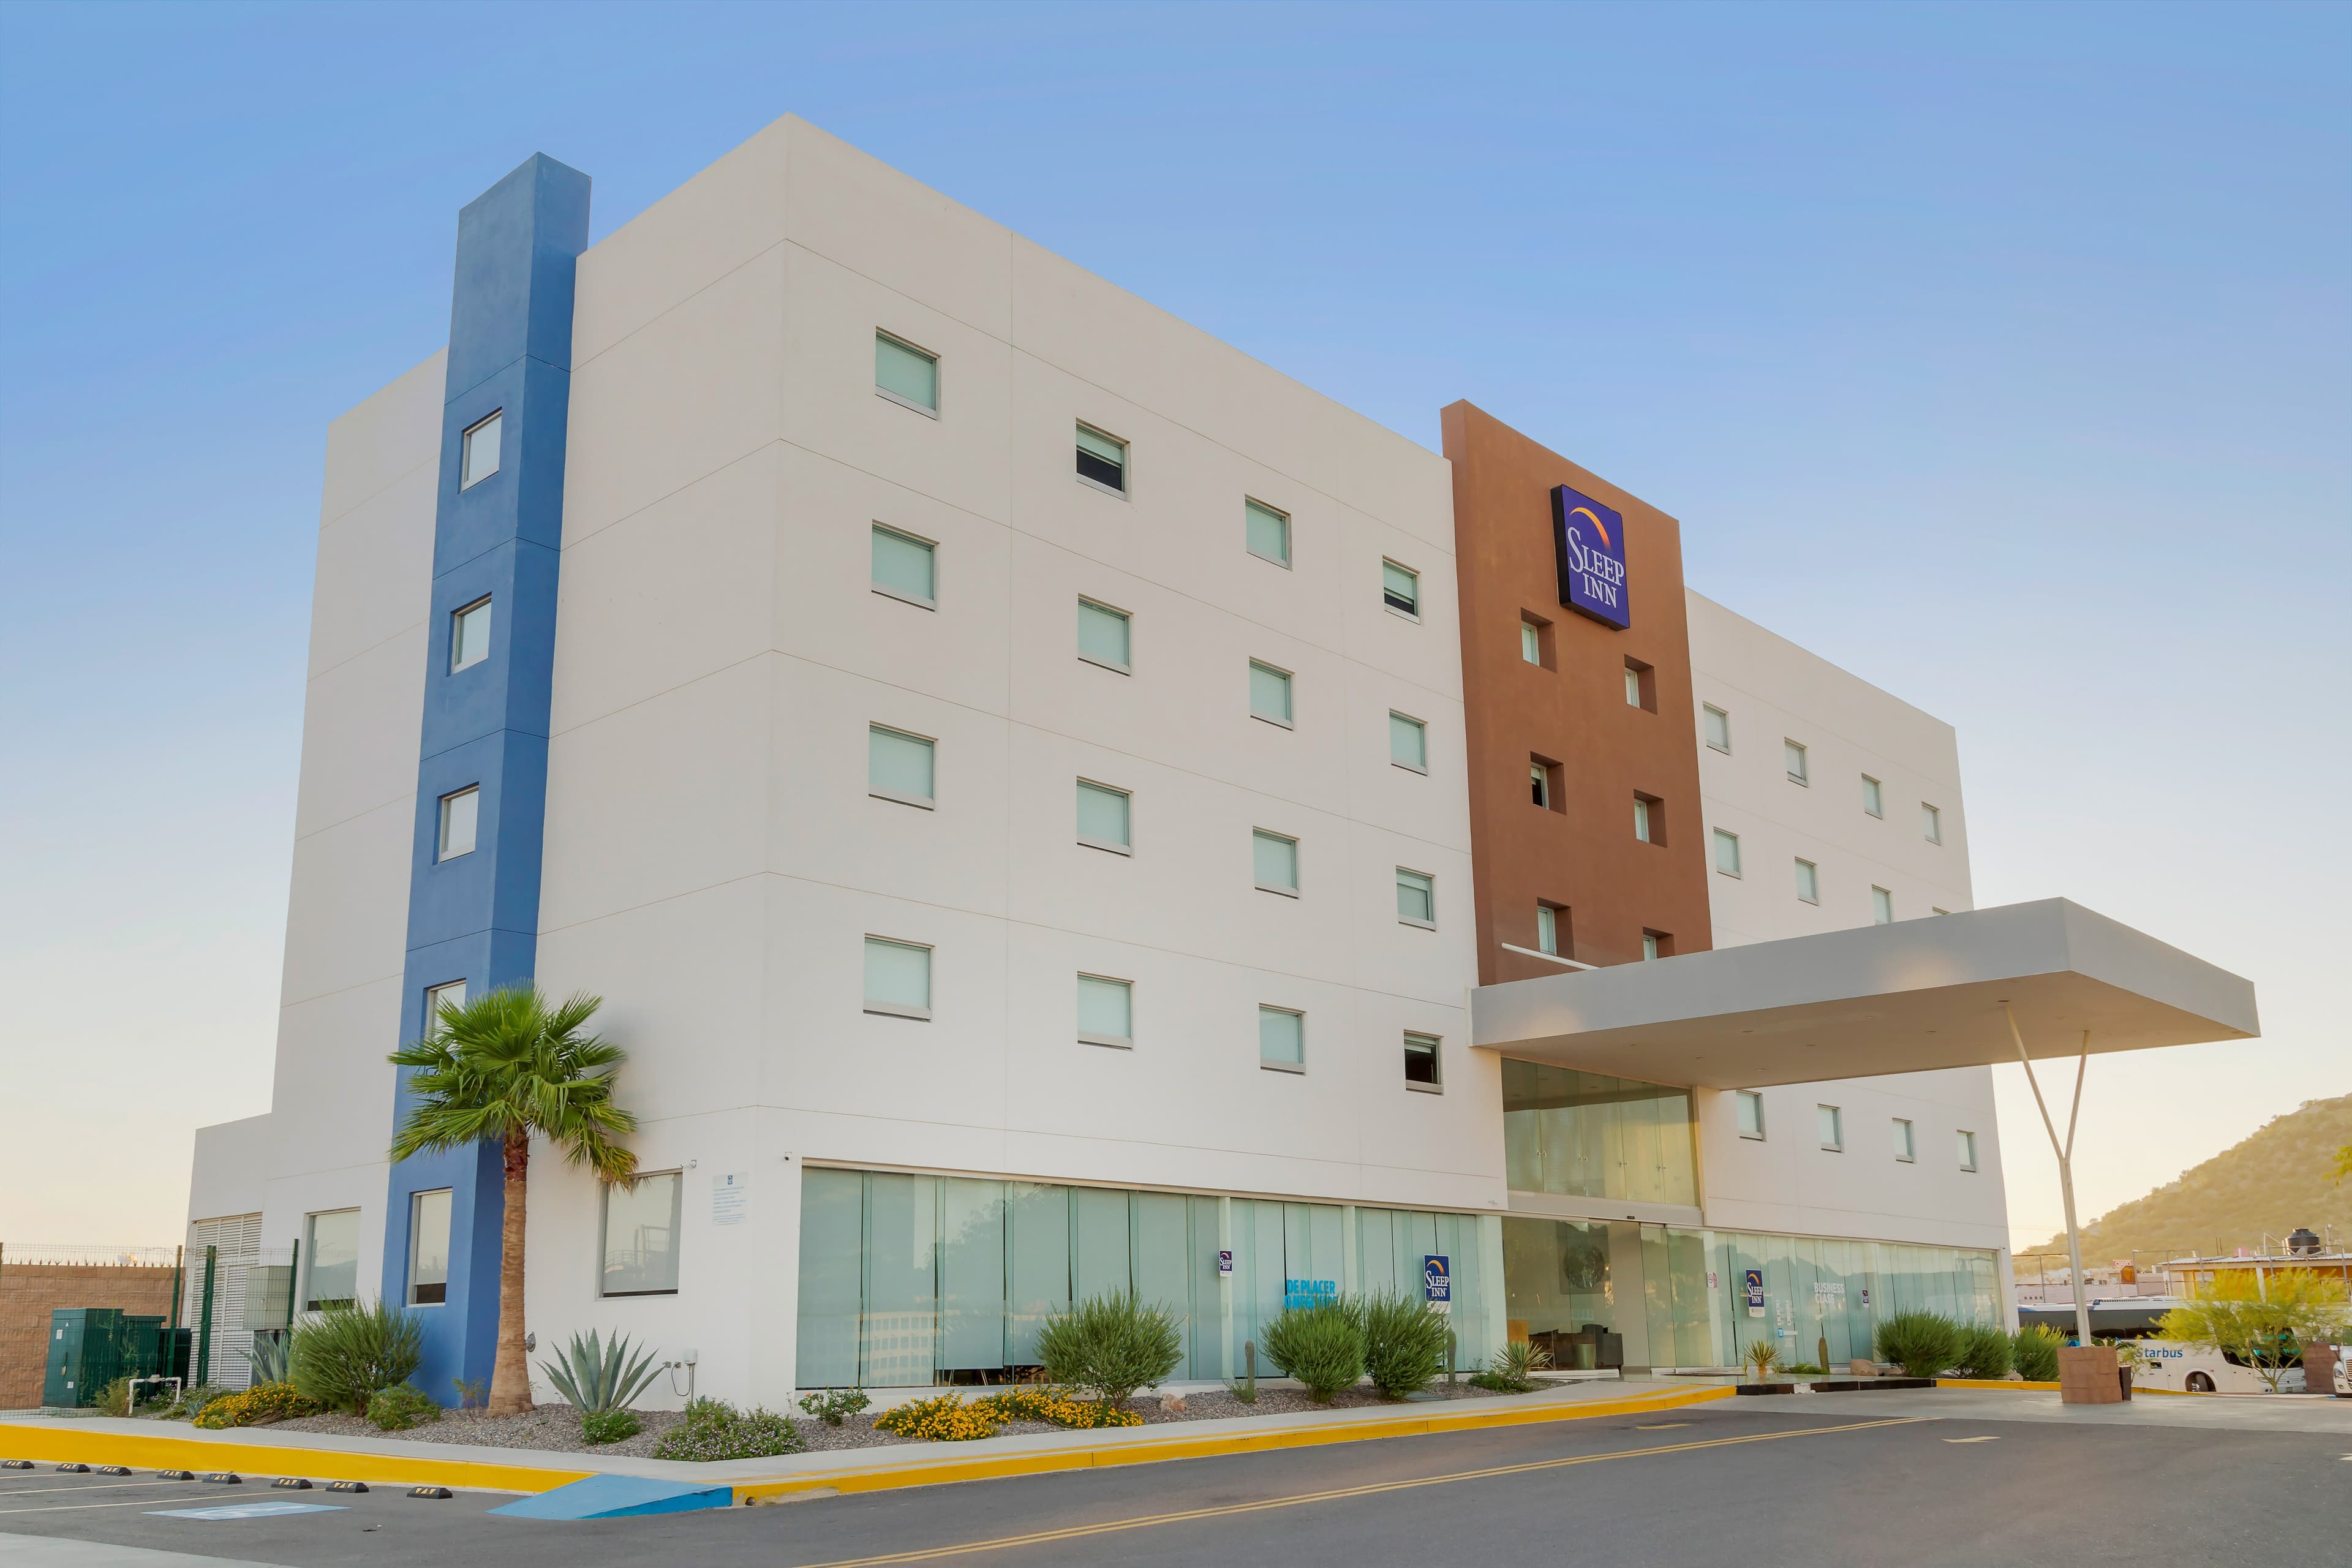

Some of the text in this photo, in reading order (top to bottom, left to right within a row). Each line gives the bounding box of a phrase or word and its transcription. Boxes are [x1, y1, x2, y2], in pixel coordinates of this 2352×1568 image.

[1567, 527, 1624, 586] SLEEP
[1583, 573, 1617, 608] INN
[1426, 1270, 1449, 1289] SLEEP
[1287, 1280, 1335, 1294] DE PLACER
[1431, 1287, 1446, 1297] INN
[1747, 1282, 1763, 1297] SLEEP
[1814, 1281, 1845, 1294] BUSINESS
[1815, 1293, 1835, 1304] CLASS
[2136, 1348, 2183, 1357] Starbus
